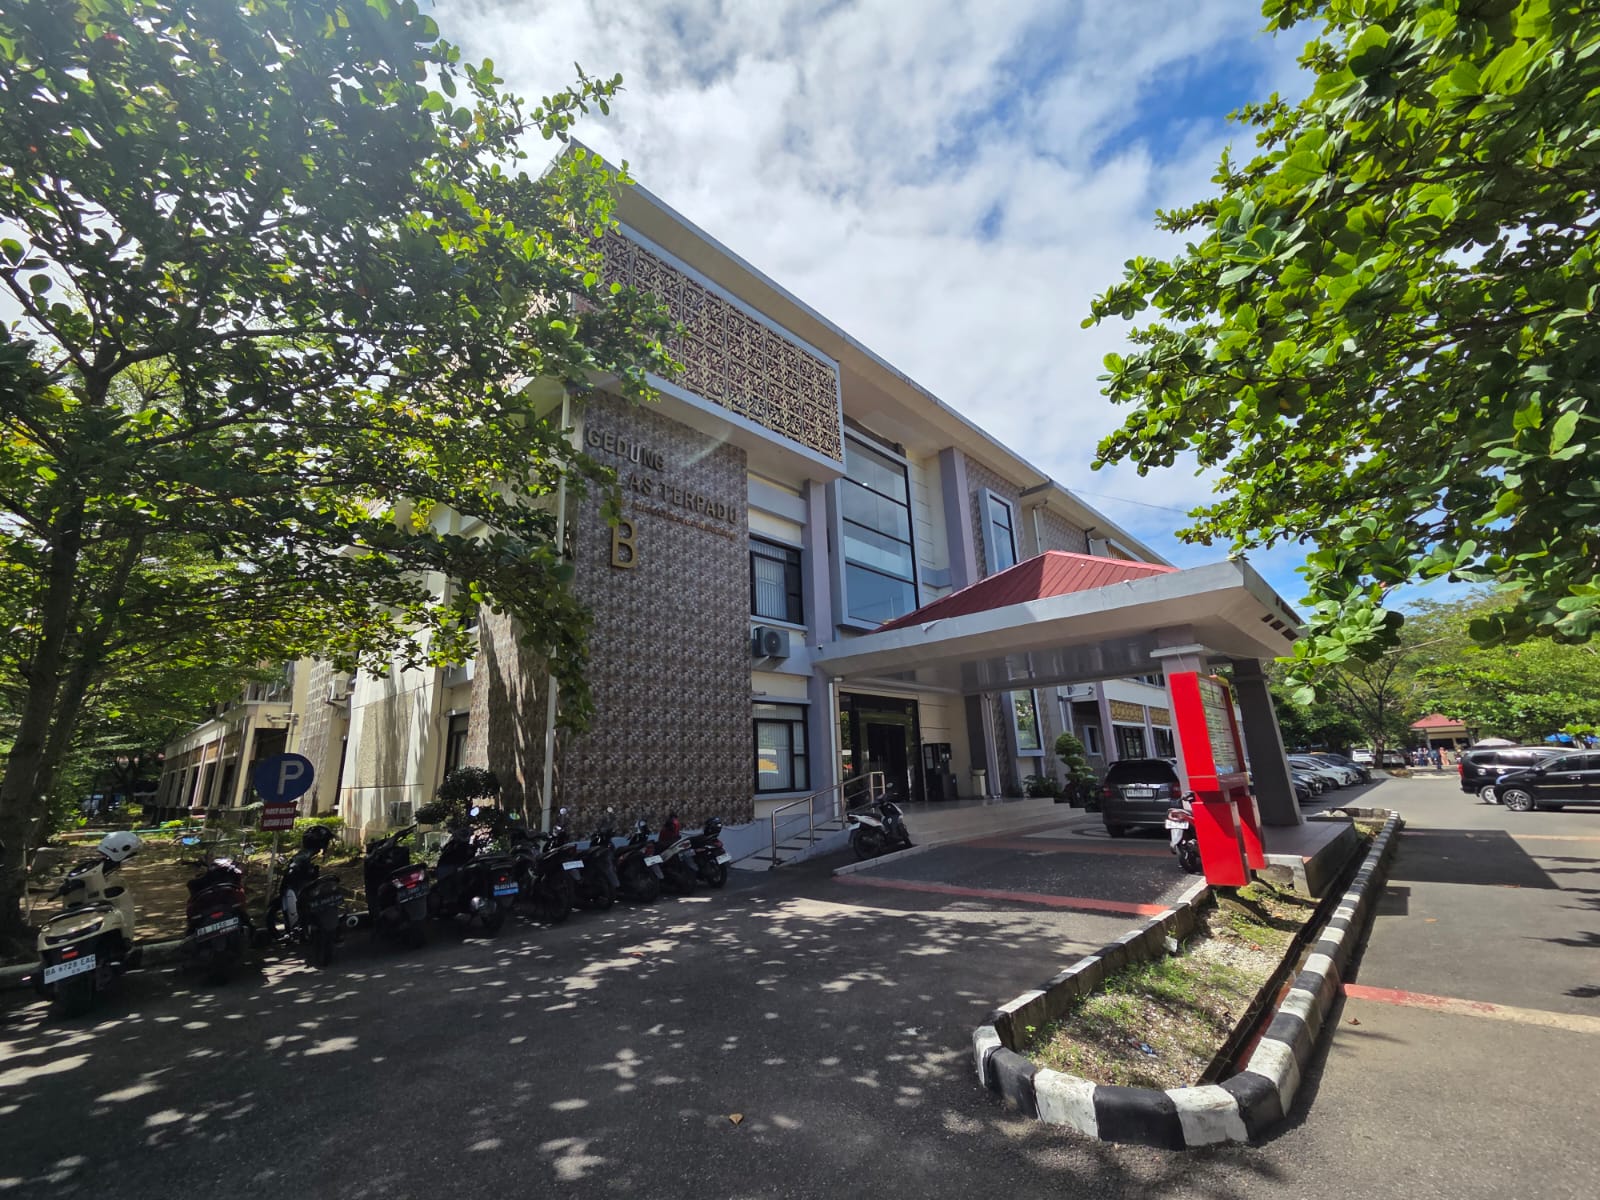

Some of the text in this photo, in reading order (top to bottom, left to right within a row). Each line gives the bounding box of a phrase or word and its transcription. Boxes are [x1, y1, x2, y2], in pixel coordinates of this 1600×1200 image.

[587, 428, 665, 472] GEDUNG
[658, 482, 738, 525] TERPADU
[611, 517, 638, 569] B
[277, 760, 305, 795] P
